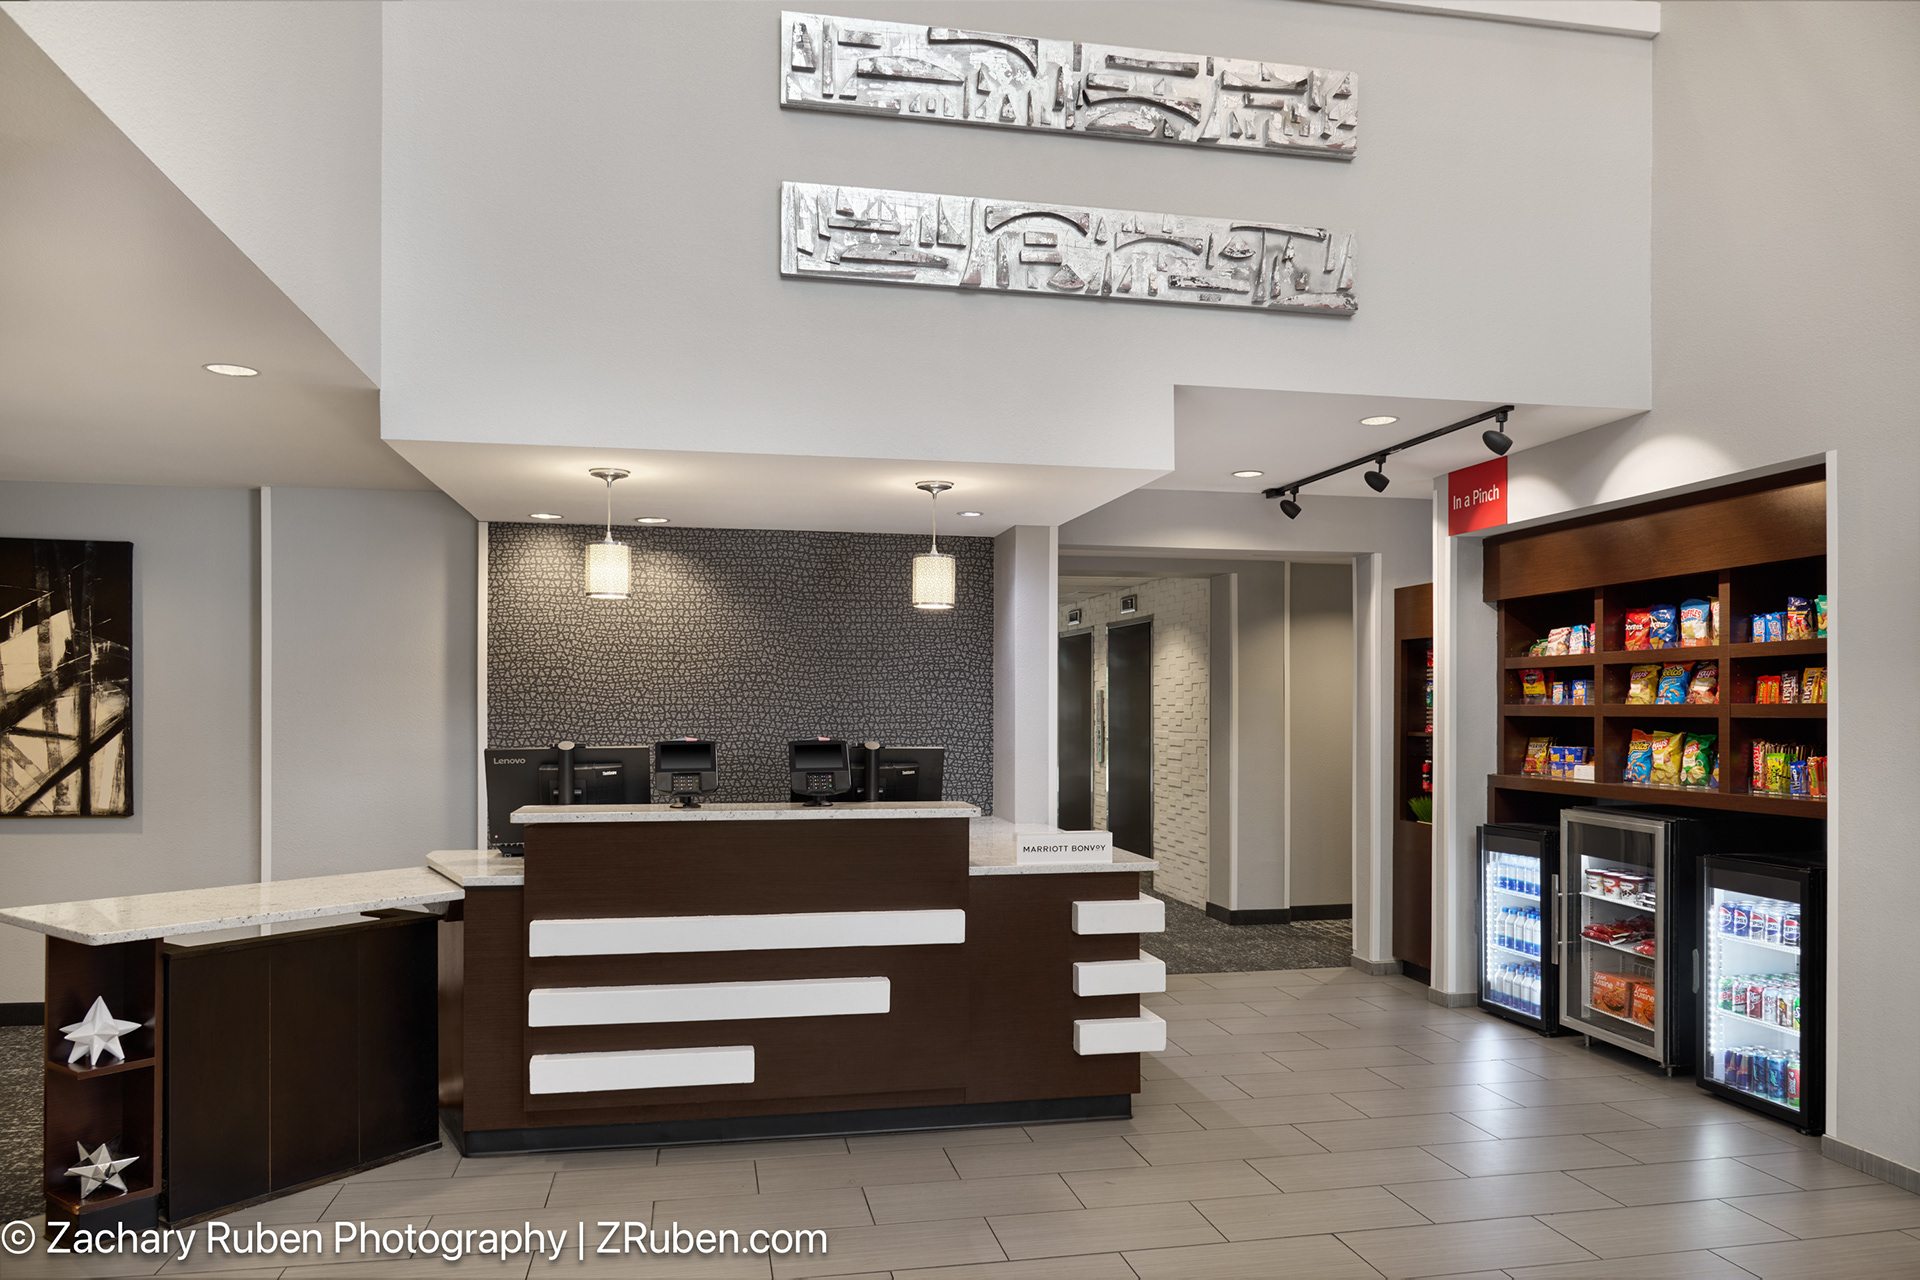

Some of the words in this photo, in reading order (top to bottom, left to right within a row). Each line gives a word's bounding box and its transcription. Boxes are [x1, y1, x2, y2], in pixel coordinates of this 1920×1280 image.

[1453, 495, 1462, 510] In
[1464, 495, 1470, 508] a
[1472, 484, 1500, 505] Pinch
[1625, 623, 1644, 631] oritos
[1662, 665, 1684, 677] eetos
[493, 757, 526, 765] Lenovo
[1022, 845, 1069, 853] MARRIOTT
[1071, 844, 1106, 852] BONVOY
